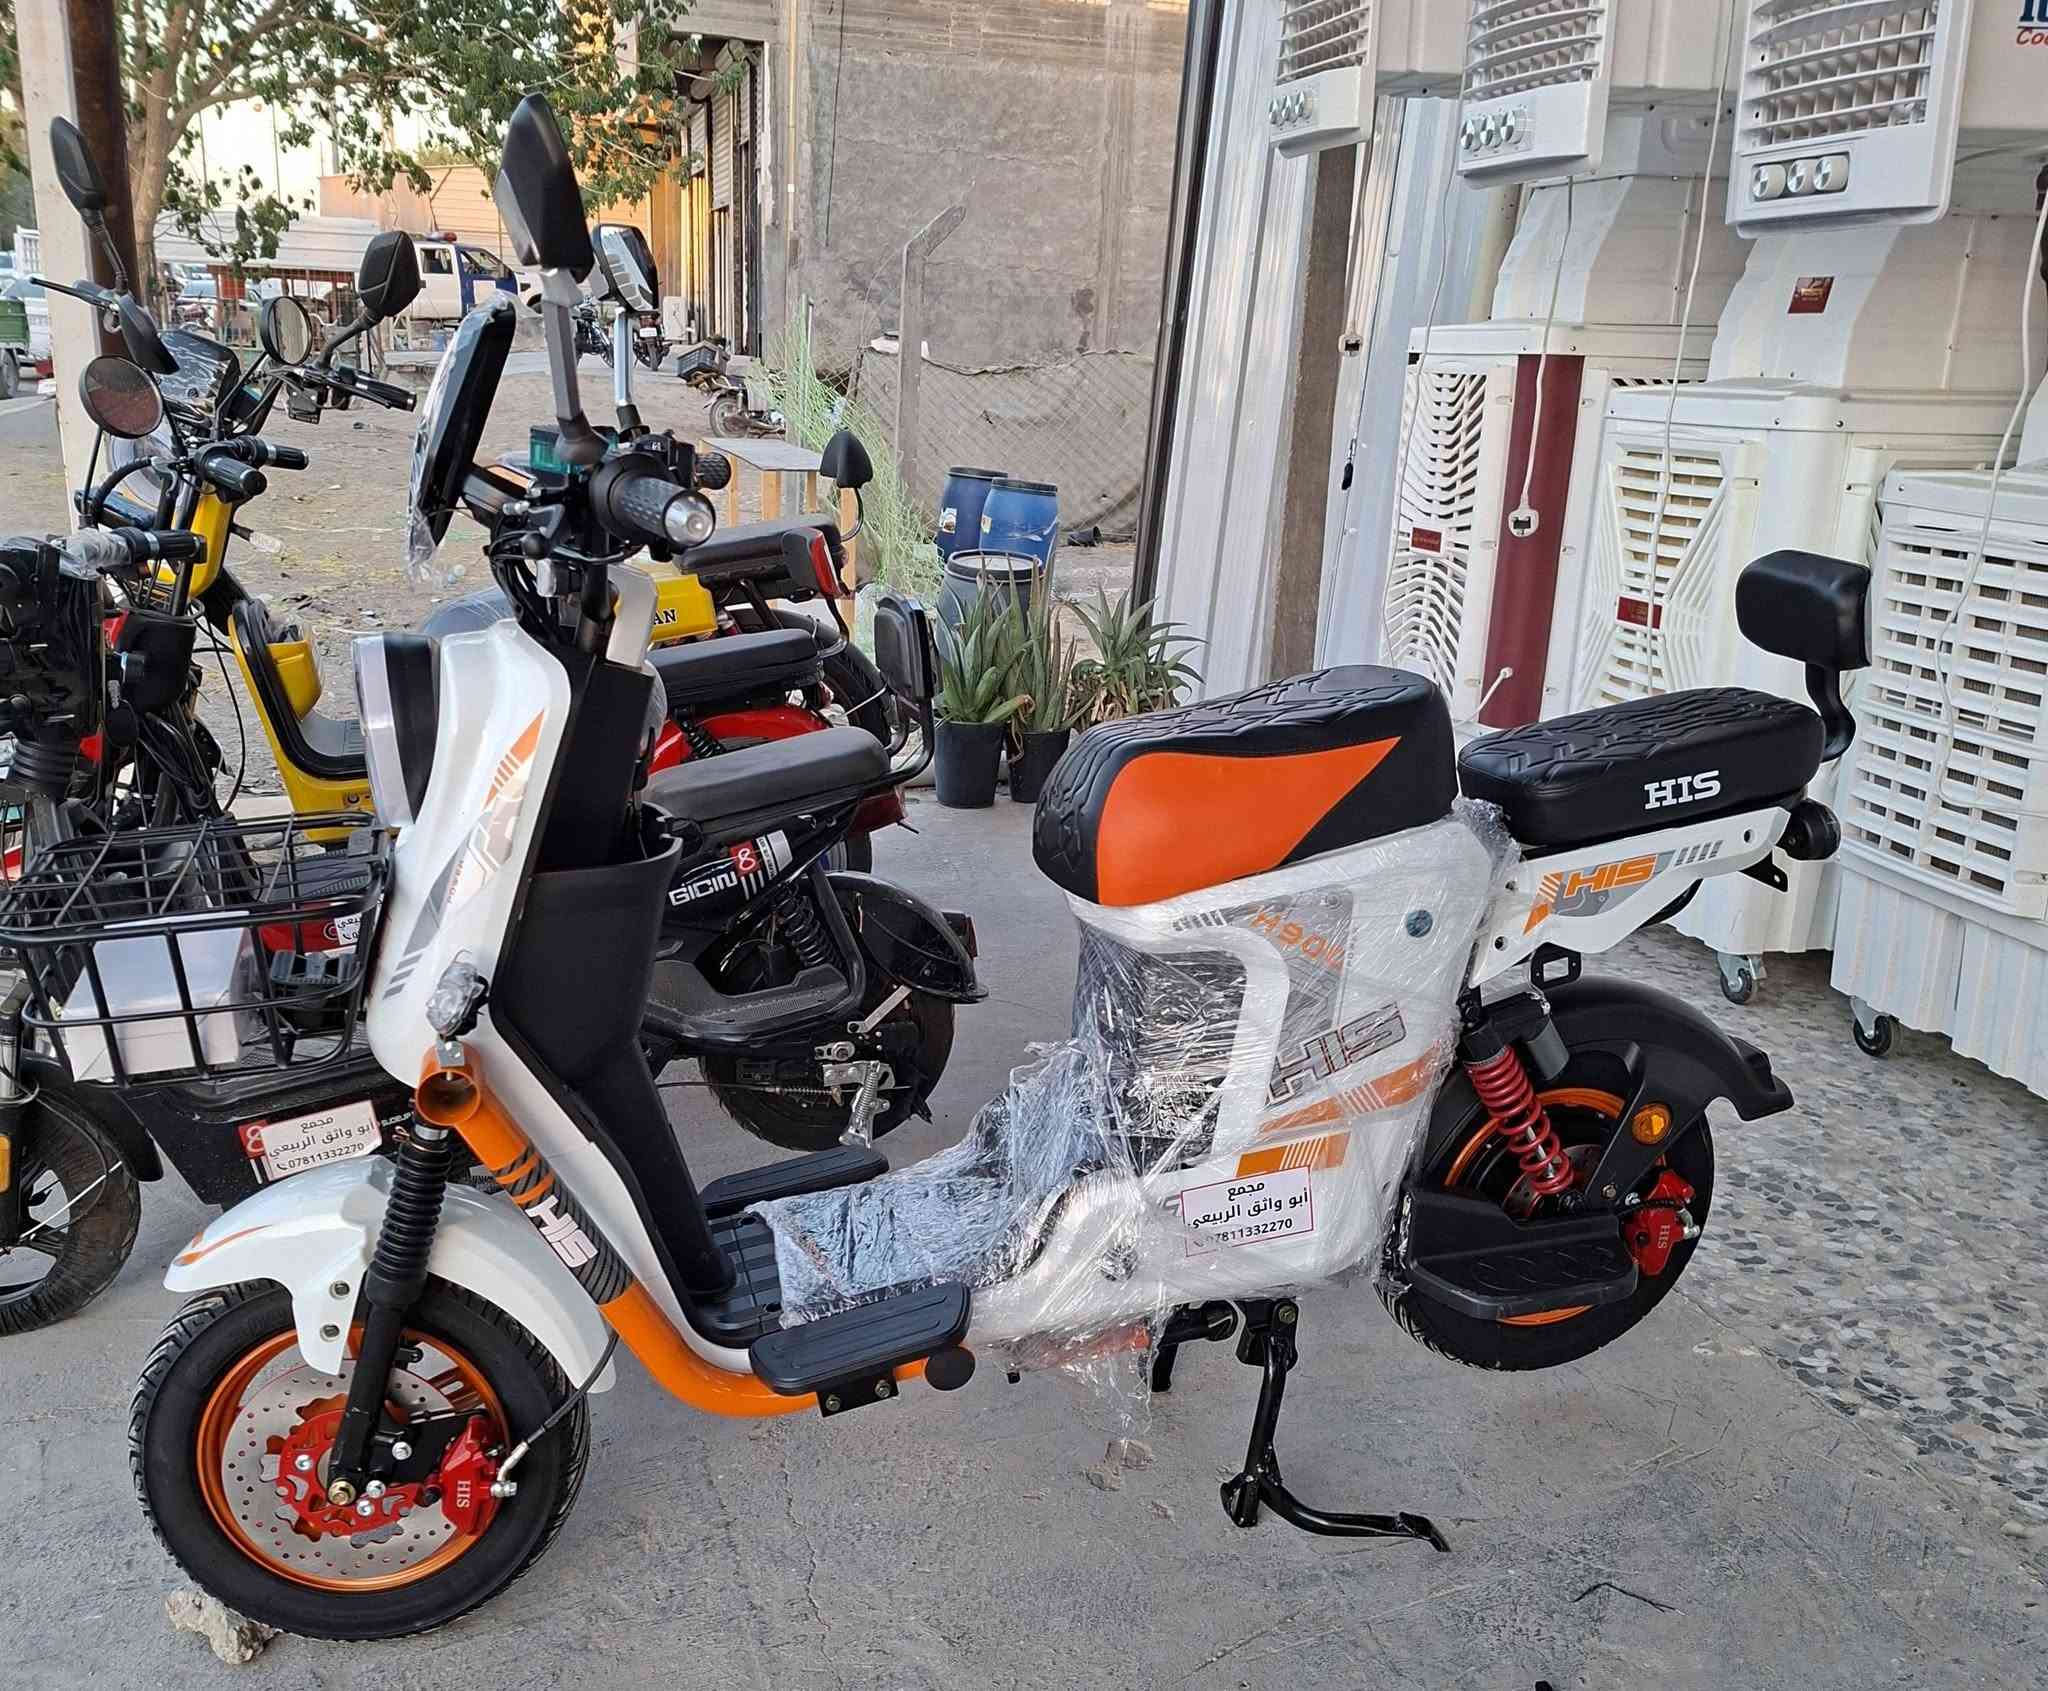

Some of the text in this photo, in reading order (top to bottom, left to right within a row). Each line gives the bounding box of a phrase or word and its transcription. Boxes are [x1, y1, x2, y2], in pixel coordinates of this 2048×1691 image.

[653, 608, 676, 625] AN
[1643, 770, 1721, 809] HIS
[1563, 853, 1659, 899] HIS
[1267, 1002, 1407, 1104] HIS
[300, 1116, 334, 1134] مجمع
[288, 1142, 365, 1169] 07811332270
[1227, 1182, 1265, 1201] مجمع
[1247, 1195, 1283, 1217] واثق
[524, 1194, 598, 1268] HIS
[1658, 1225, 1670, 1248] HIS
[457, 1480, 471, 1508] HIS
